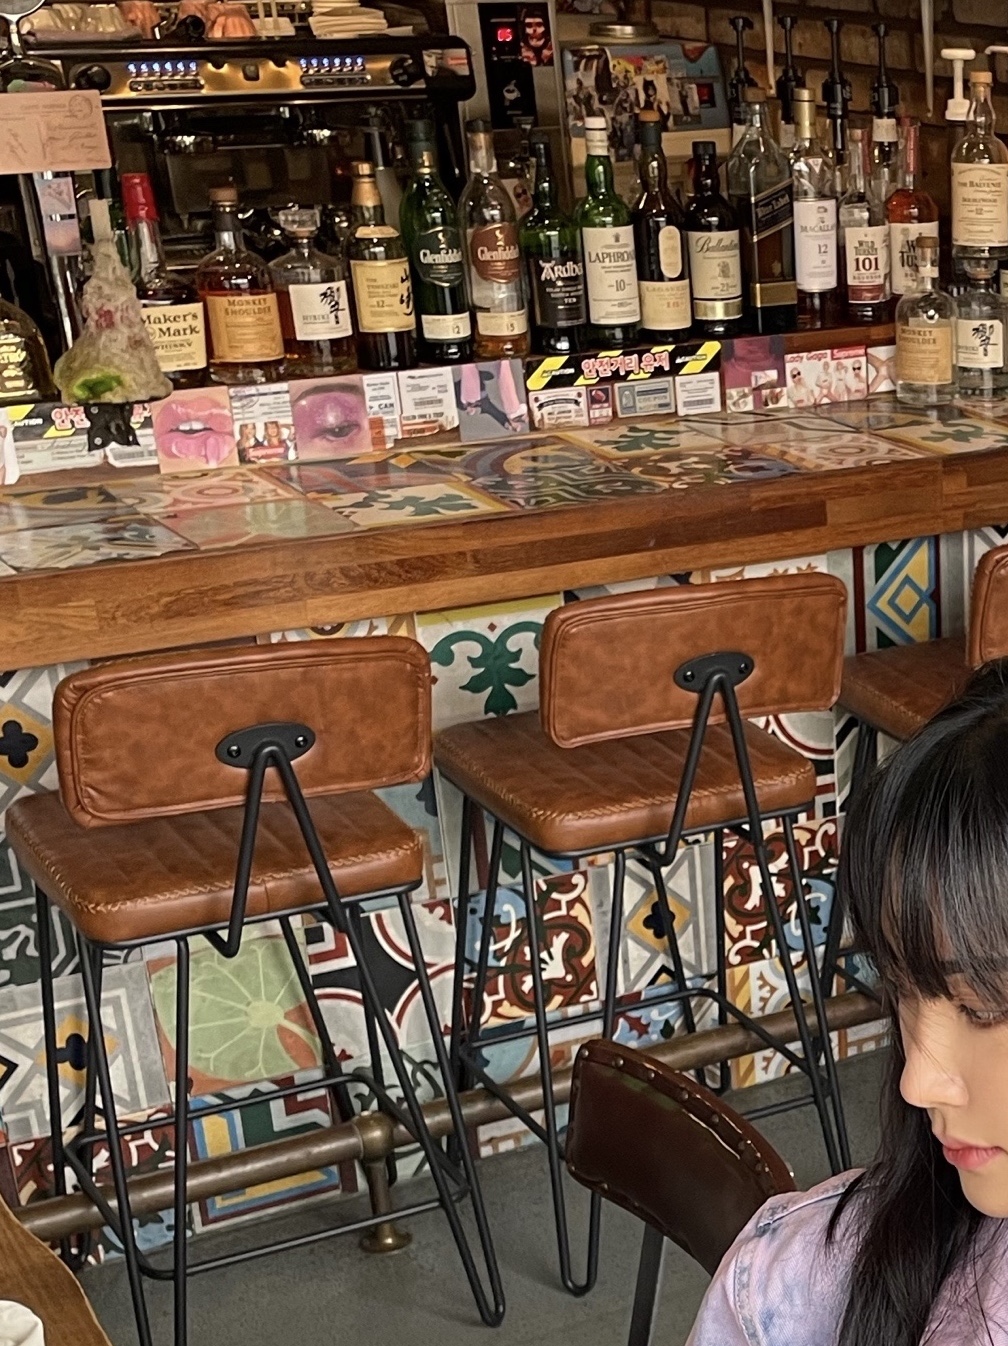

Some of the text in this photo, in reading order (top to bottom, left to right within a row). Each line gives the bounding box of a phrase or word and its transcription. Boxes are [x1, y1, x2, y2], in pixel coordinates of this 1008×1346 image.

[817, 244, 828, 254] 12
[854, 257, 880, 272] 101
[616, 280, 626, 292] 10
[227, 298, 267, 307] MONKEY
[224, 305, 272, 316] SHOULDER
[158, 324, 200, 339] Mark
